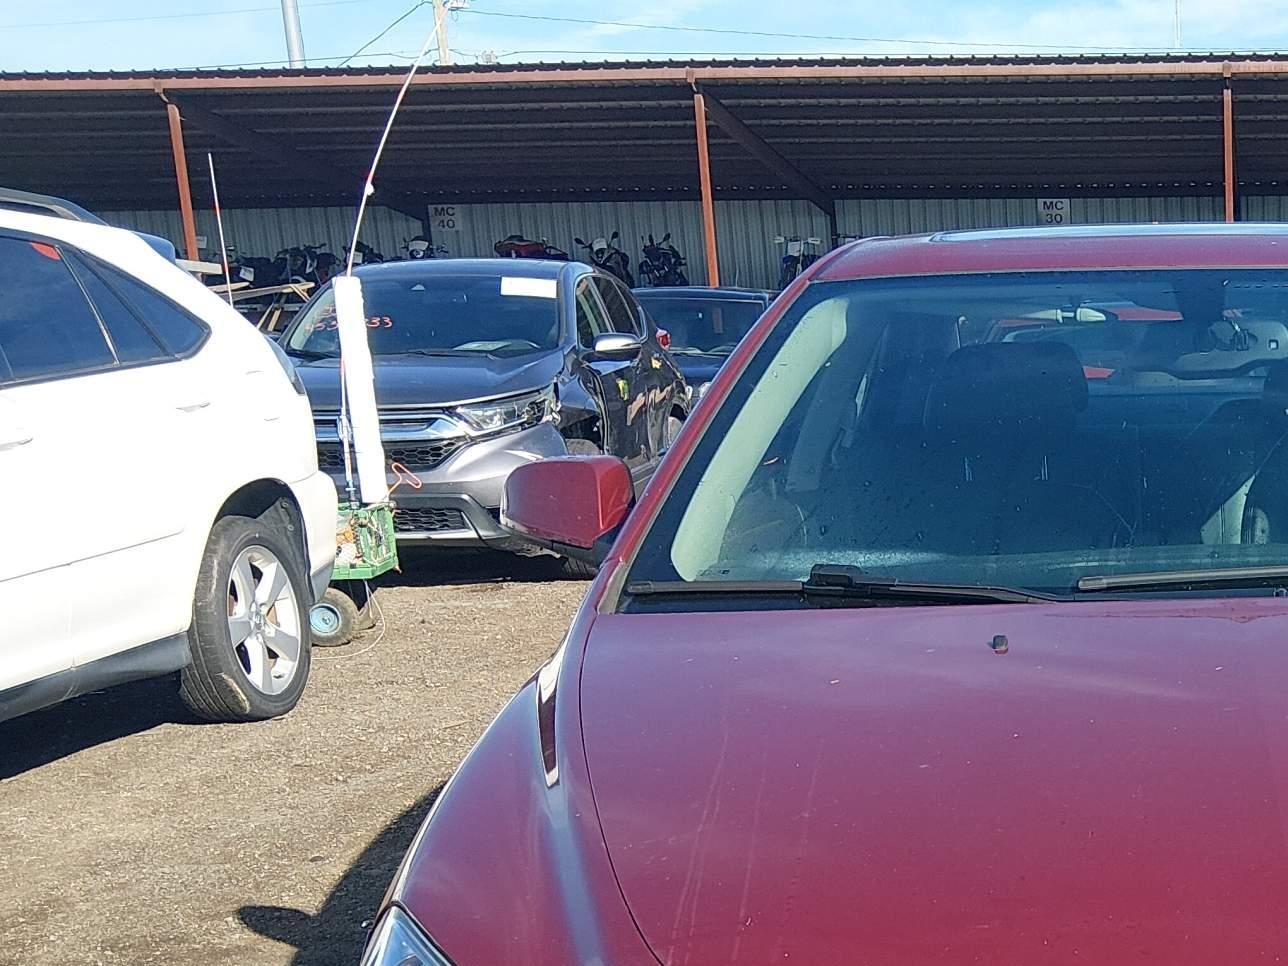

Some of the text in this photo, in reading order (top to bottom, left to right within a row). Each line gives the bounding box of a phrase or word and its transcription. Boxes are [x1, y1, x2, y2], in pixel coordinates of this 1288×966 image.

[1042, 200, 1065, 211] MC
[433, 206, 456, 217] MC
[438, 219, 456, 229] 40
[1045, 213, 1063, 224] 30
